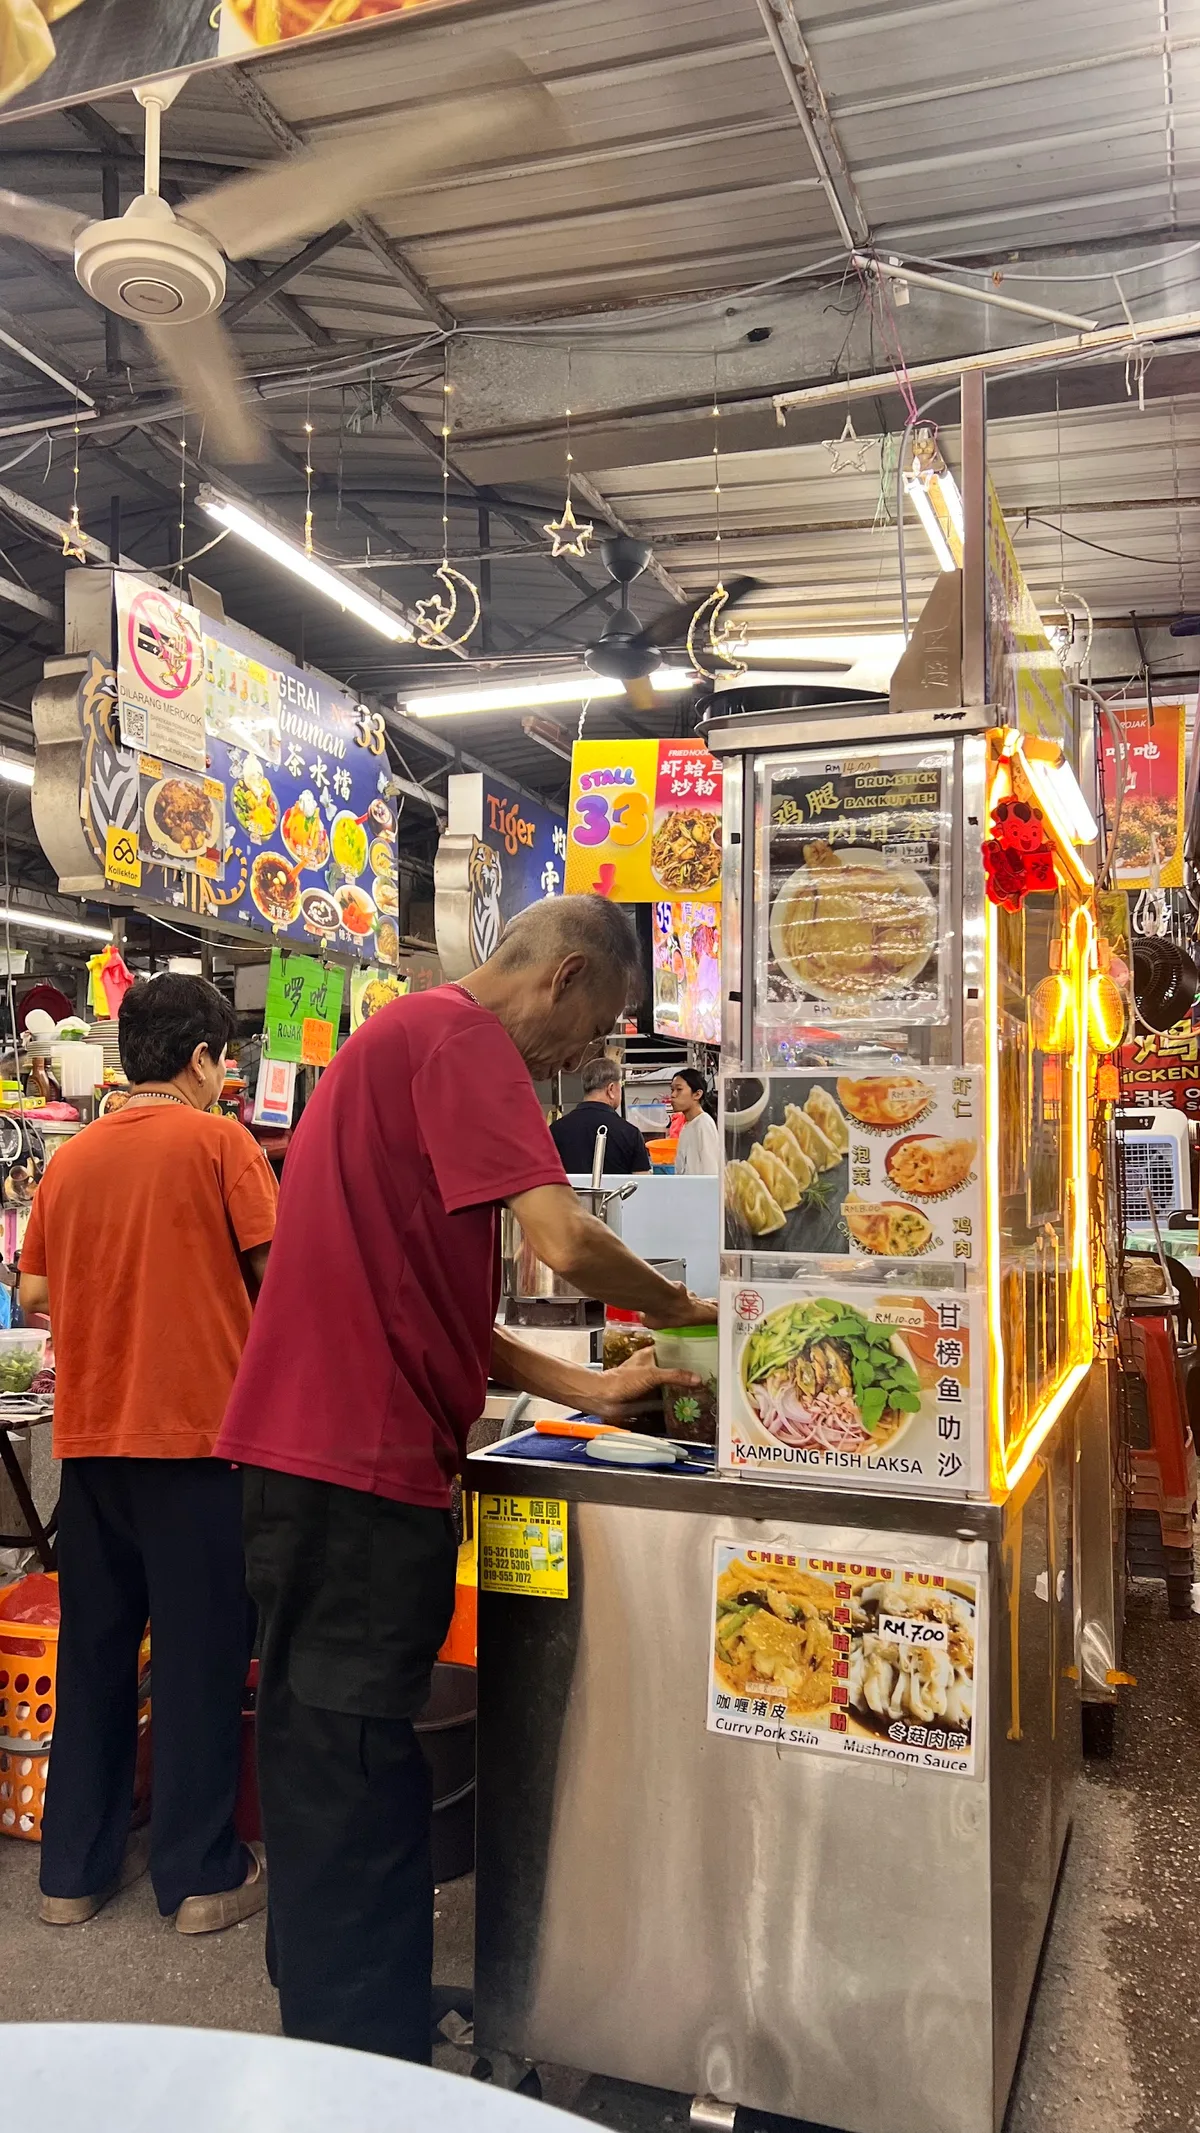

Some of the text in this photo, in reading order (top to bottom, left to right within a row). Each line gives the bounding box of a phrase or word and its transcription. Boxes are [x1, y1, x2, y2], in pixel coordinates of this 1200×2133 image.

[120, 685, 203, 726] DILARANG MEROKOK
[279, 671, 320, 716] GERAI
[279, 698, 347, 760] inuman
[354, 704, 386, 756] 33
[1120, 719, 1147, 729] ROJAK
[668, 749, 689, 757] FRIED
[825, 764, 840, 773] RM
[284, 742, 352, 801] 茶水檔
[579, 768, 635, 791] STALL
[670, 777, 718, 797] 炒粉
[855, 771, 937, 788] DRUMSTICK
[772, 781, 842, 828] 鸡腿
[844, 792, 937, 809] BAK KUT TEH
[487, 794, 536, 856] Tiger
[572, 792, 649, 846] 33
[108, 865, 139, 880] Kollektor
[277, 1023, 301, 1041] ROJAK
[952, 1076, 972, 1119] 虾仁
[844, 1100, 938, 1138] PRAWN DUMPLING
[852, 1145, 871, 1186] 泡菜
[881, 1171, 978, 1204] KIMCHI DUMPLING
[836, 1221, 880, 1256] CHICKEN
[952, 1216, 972, 1259] 鸡肉
[936, 1302, 962, 1478] 甘榜鱼叻沙
[736, 1444, 923, 1474] KAMPUNG FISH LAKSA
[746, 1550, 946, 1588] CHEE CHEONG FUN
[715, 1694, 787, 1720] 咖喱猪皮
[756, 1724, 786, 1741] Pork
[790, 1730, 819, 1746] Skin
[888, 1722, 968, 1751] 冬菇肉碎
[843, 1738, 968, 1771] Mushroom Sauce
